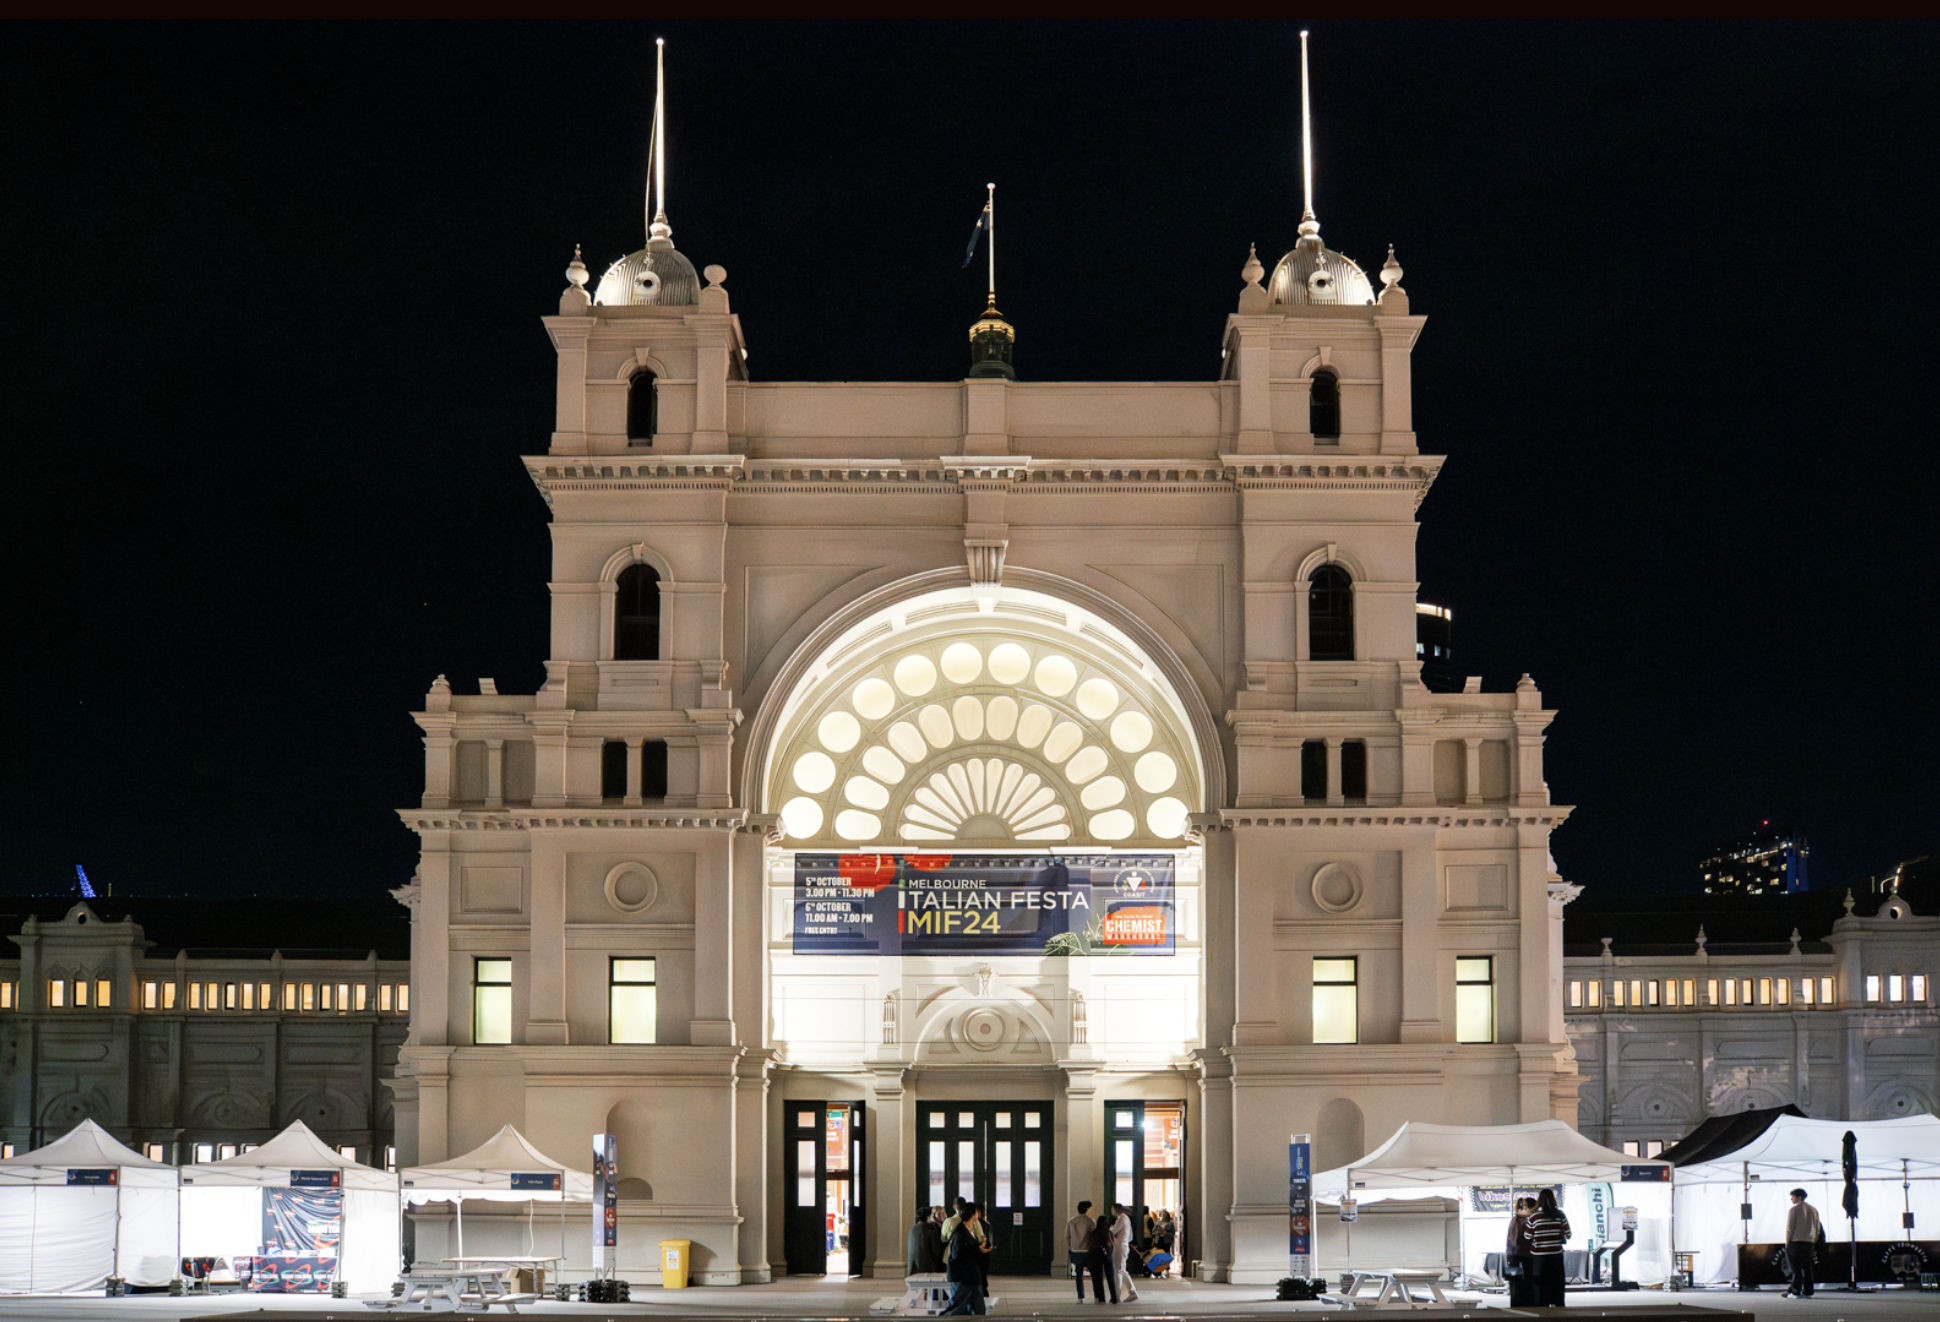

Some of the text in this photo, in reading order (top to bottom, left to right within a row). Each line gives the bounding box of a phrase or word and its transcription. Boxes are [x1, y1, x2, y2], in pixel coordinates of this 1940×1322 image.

[817, 877, 852, 886] OCTOBER
[908, 879, 987, 889] MELBOURNE
[806, 888, 824, 897] 3.00
[825, 888, 836, 897] PM
[842, 888, 862, 897] 11.30
[863, 888, 875, 897] PM
[898, 890, 1090, 910] ITALIAN FESTA
[816, 902, 852, 912] OCTOBER
[805, 913, 825, 923] 11.00
[826, 913, 838, 923] AM
[843, 913, 860, 923] 7.00
[861, 913, 874, 923] PM
[907, 910, 1001, 935] MIF24
[1106, 919, 1163, 933] CHEMIST
[1591, 1187, 1606, 1244] ianchi
